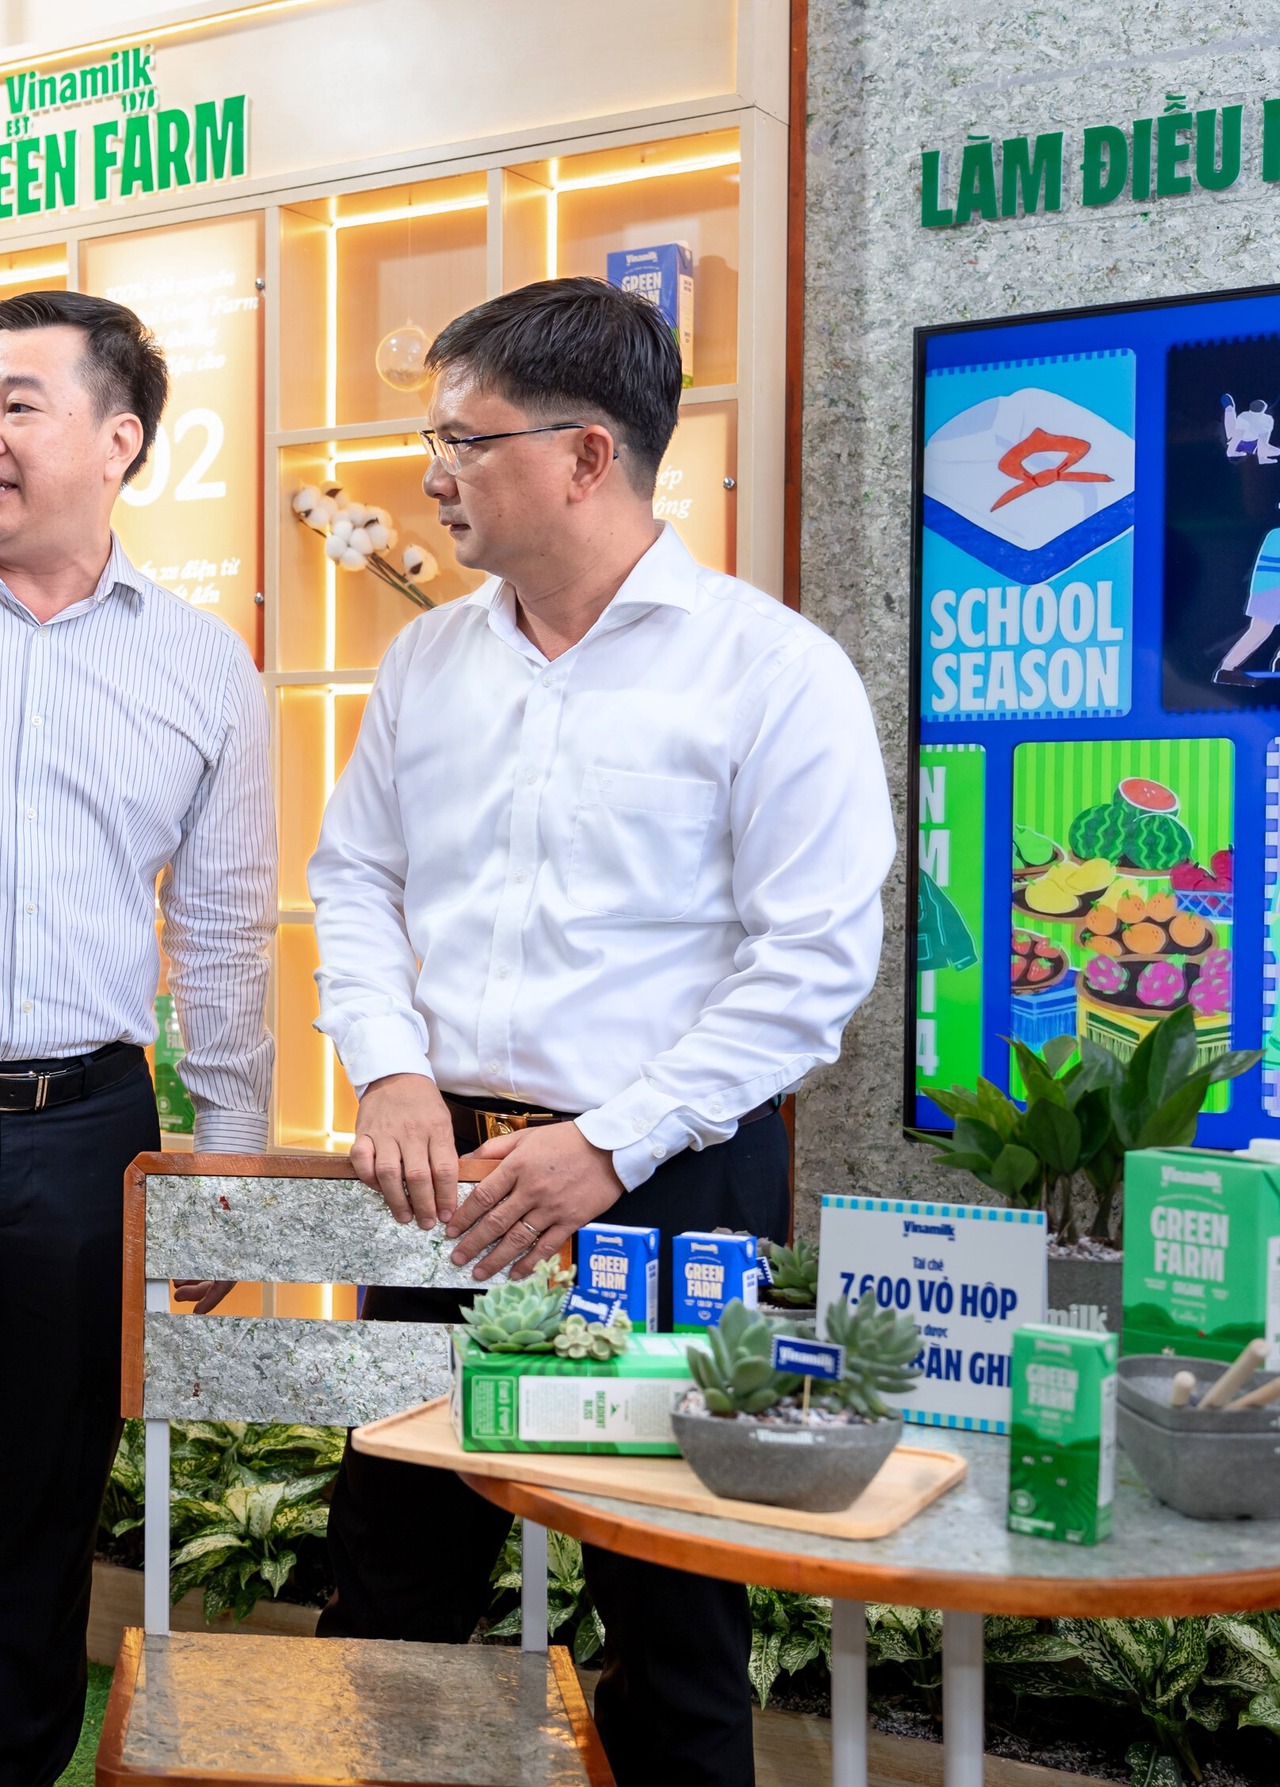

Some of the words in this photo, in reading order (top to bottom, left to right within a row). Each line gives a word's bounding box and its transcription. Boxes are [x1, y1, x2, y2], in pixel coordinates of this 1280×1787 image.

[5, 44, 154, 114] Vinamilk
[7, 116, 30, 138] EST
[93, 94, 248, 201] FARM
[920, 131, 1064, 228] LÀM
[1080, 93, 1244, 207] ĐIỀU
[622, 271, 662, 292] GREEN
[930, 581, 1123, 649] SCHOOL
[931, 646, 1120, 713] SEASON
[902, 1220, 956, 1242] Vinamilk
[1149, 1205, 1230, 1249] GREEN
[589, 1254, 629, 1274] GREEN
[592, 1271, 627, 1291] FARM
[685, 1262, 725, 1282] GREEN
[1153, 1240, 1225, 1283] FARM
[687, 1280, 723, 1300] FARM
[839, 1272, 911, 1310] 7.600
[960, 1282, 1018, 1323] HỘP
[969, 1351, 1013, 1388] GH
